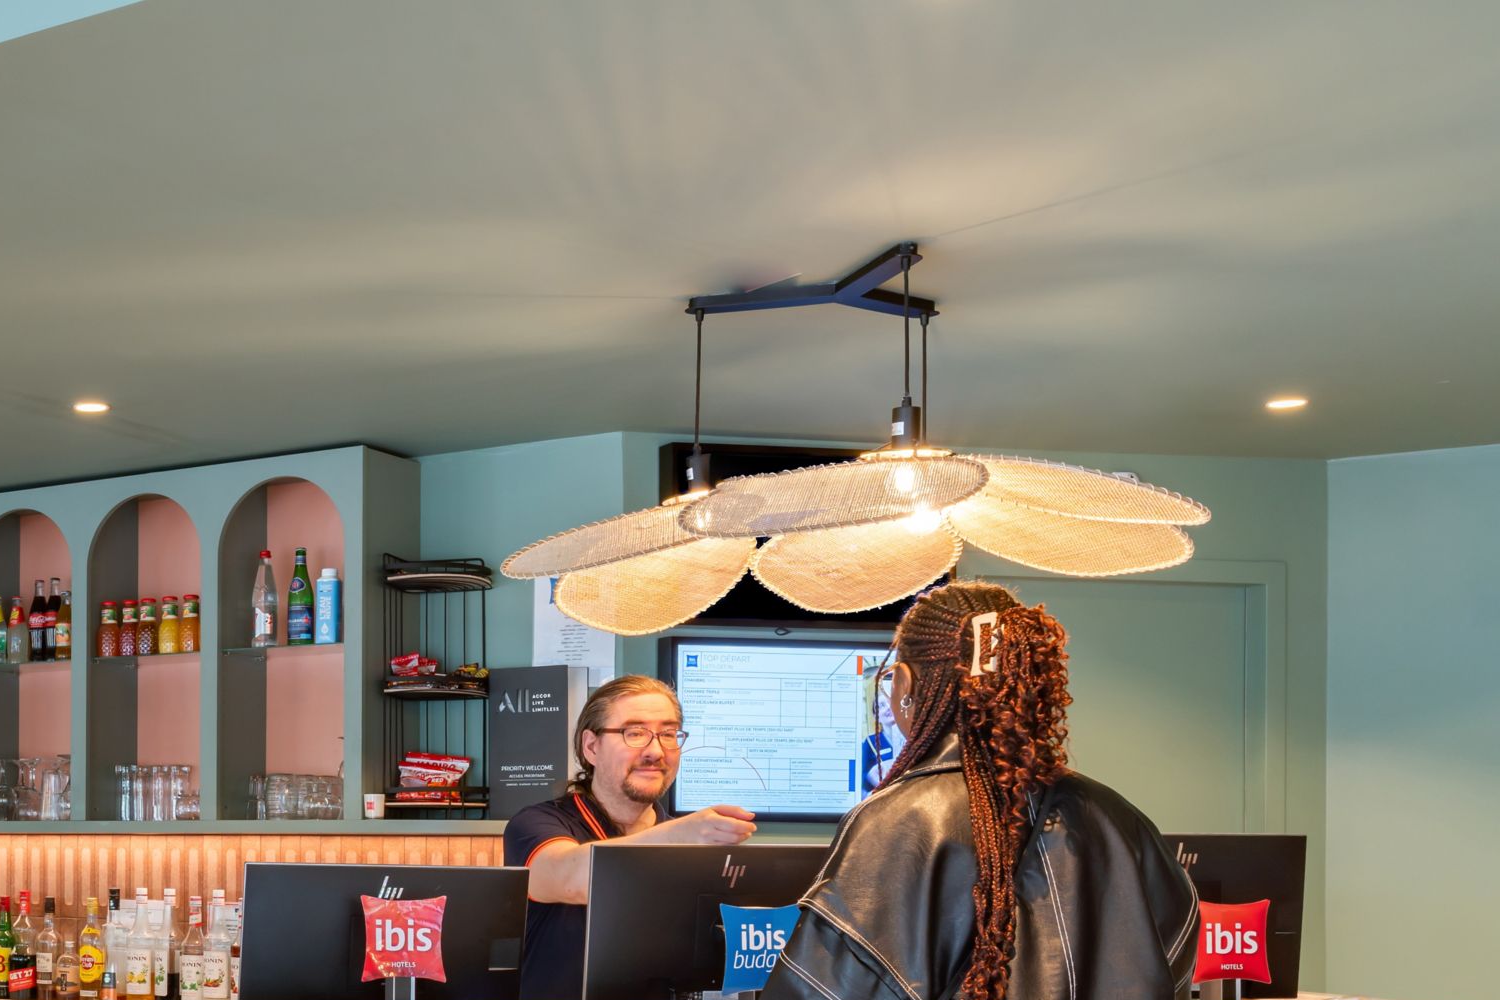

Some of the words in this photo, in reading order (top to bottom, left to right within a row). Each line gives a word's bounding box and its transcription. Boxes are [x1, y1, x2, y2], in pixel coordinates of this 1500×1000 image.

[721, 854, 746, 889] hp
[375, 919, 432, 952] ibis
[741, 923, 787, 951] ibis
[1205, 922, 1259, 955] ibis
[733, 949, 777, 973] budg
